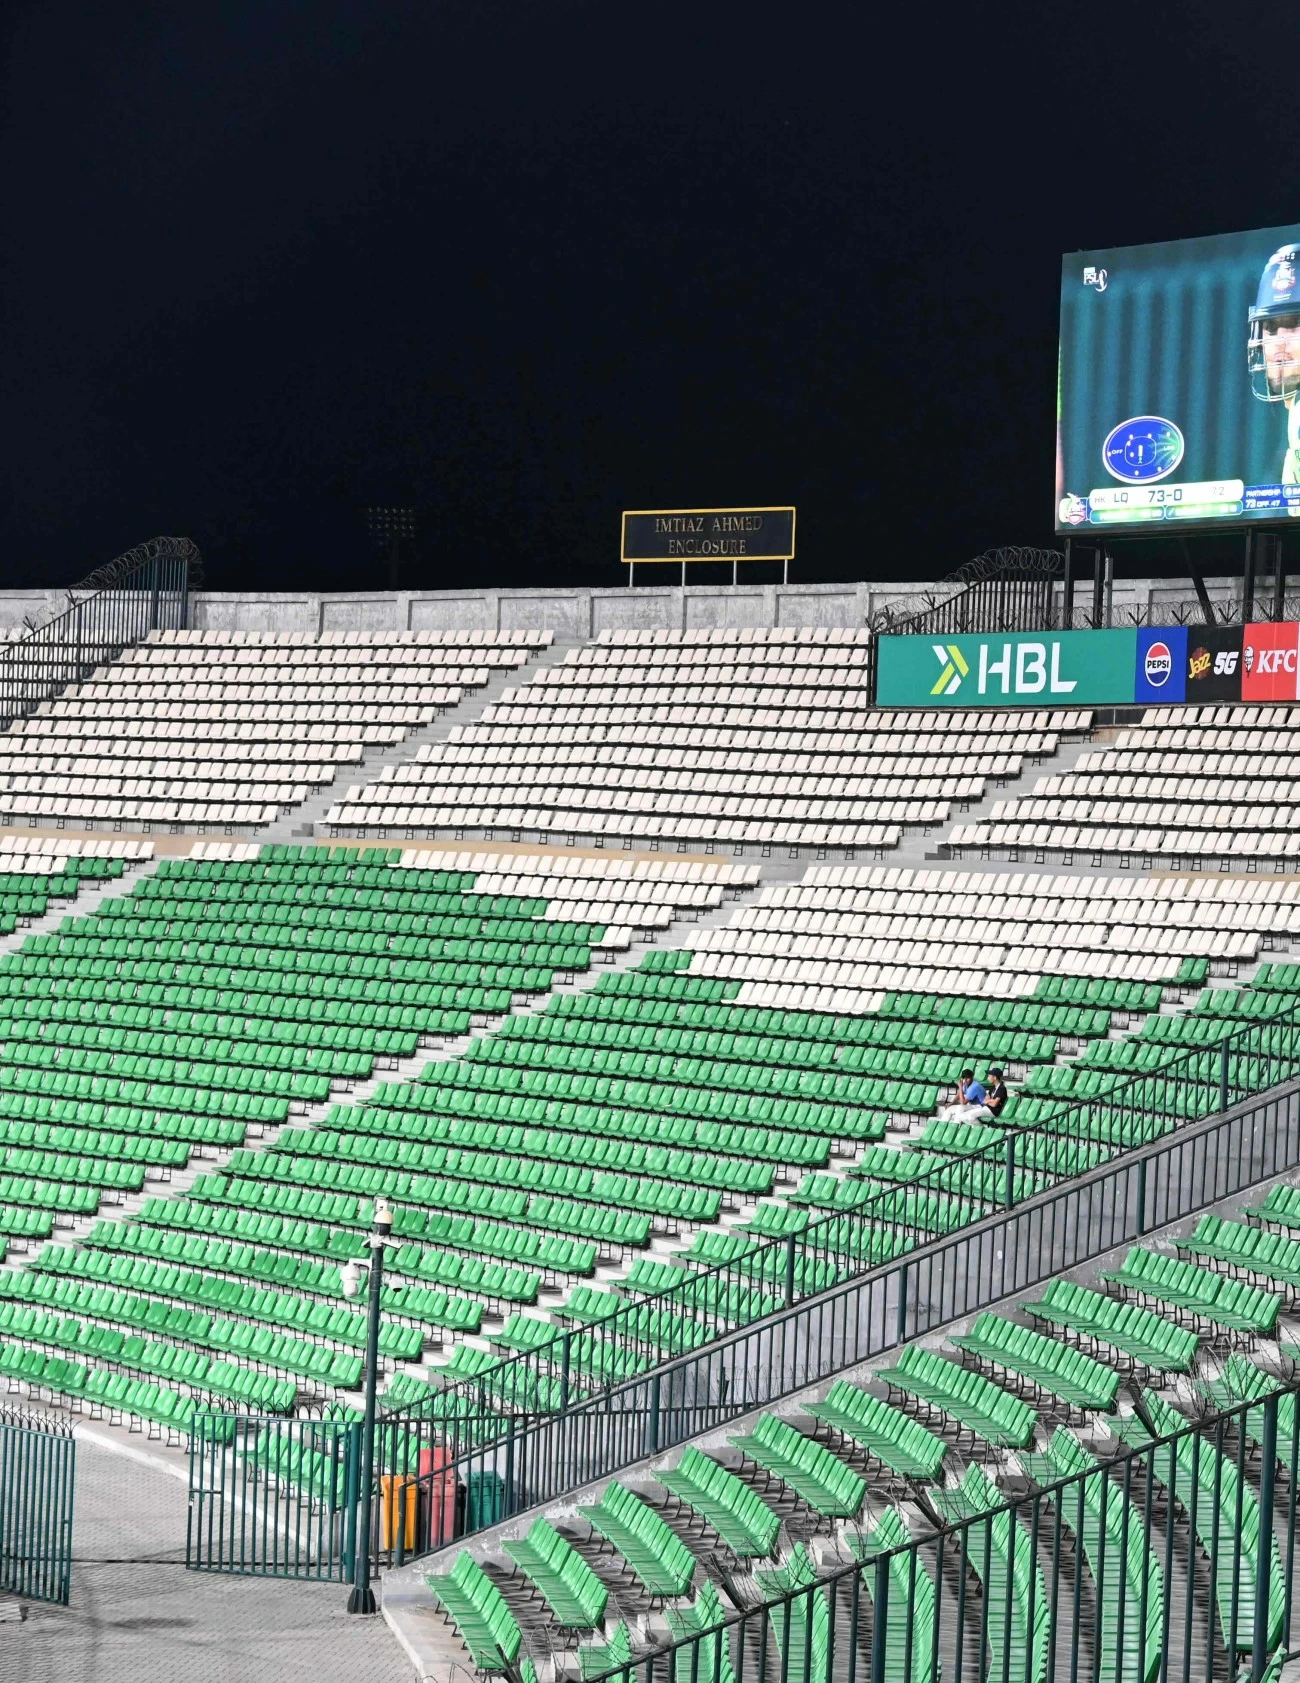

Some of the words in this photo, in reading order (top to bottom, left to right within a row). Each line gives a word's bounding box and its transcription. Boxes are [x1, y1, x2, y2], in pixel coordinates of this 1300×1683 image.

[1114, 492, 1128, 503] LQ
[655, 517, 704, 533] IMTIAZ
[712, 515, 763, 532] AHMED
[668, 539, 747, 554] ENCLOSURE
[978, 642, 1077, 694] HBL
[1146, 659, 1169, 669] PEPSI
[1188, 651, 1211, 679] Jazz
[1213, 651, 1239, 675] 5G
[1256, 649, 1297, 673] KFC
